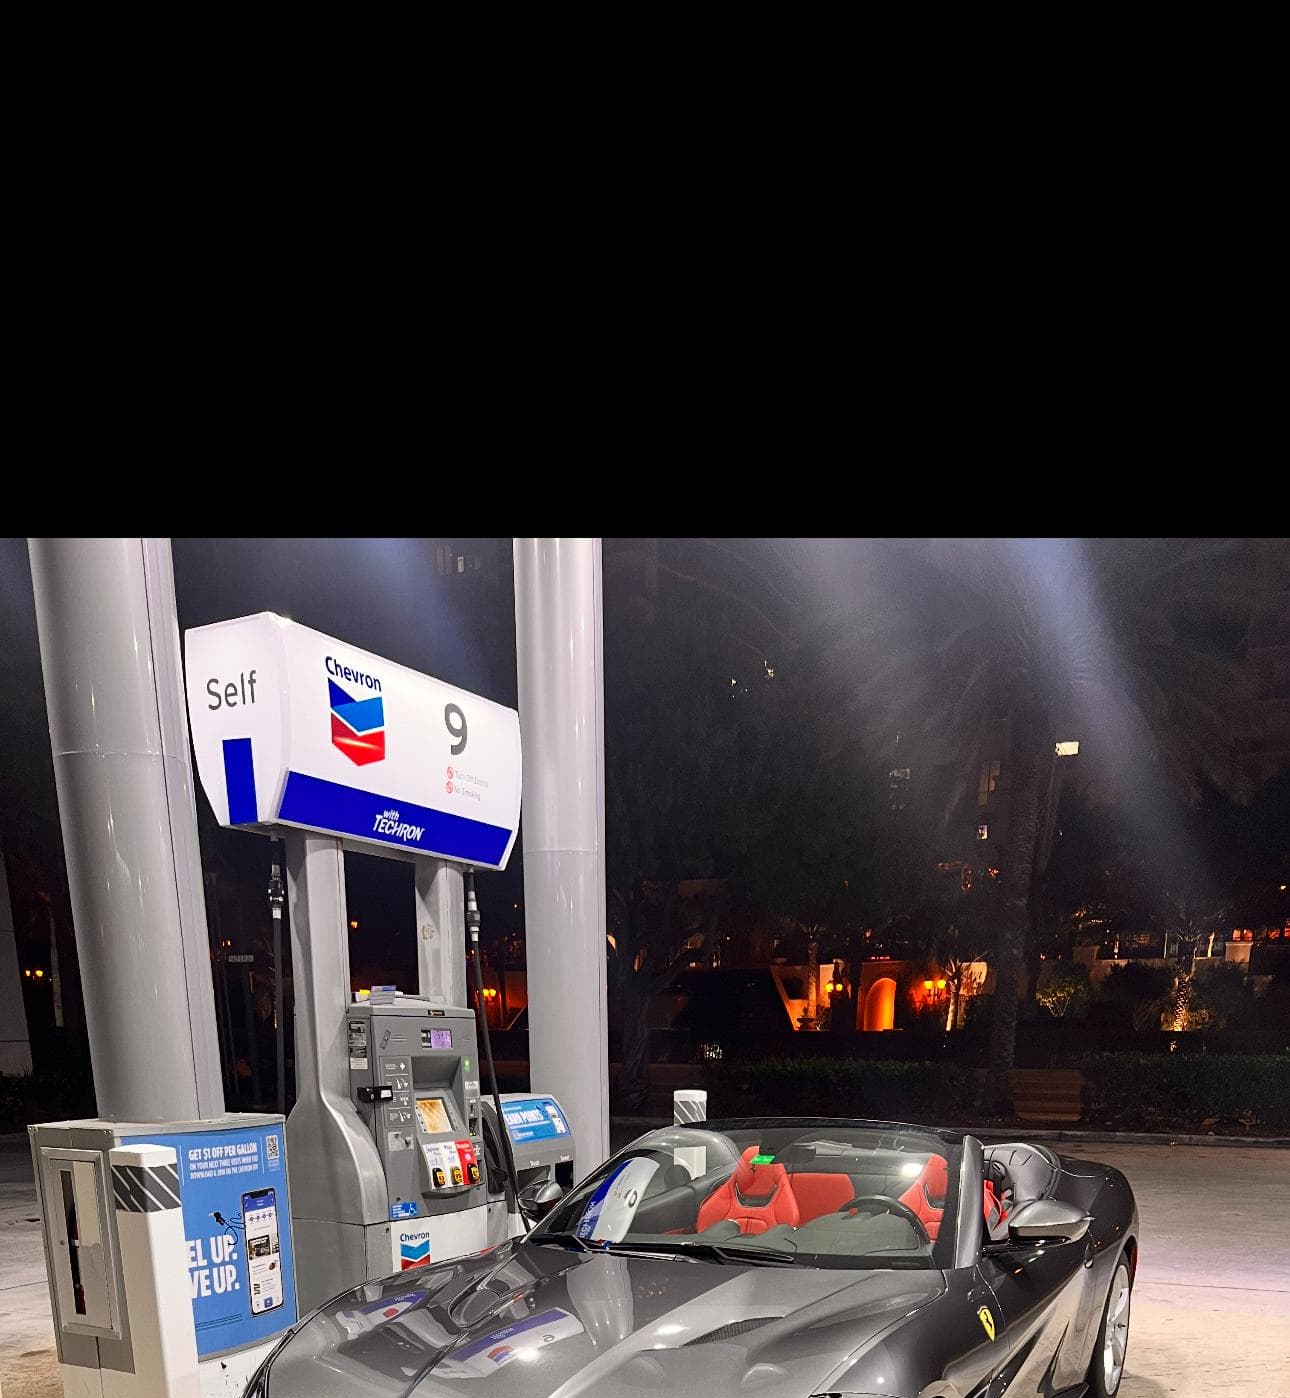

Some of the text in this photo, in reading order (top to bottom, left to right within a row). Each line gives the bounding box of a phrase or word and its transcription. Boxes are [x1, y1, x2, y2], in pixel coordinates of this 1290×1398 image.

[206, 669, 257, 711] Self
[325, 656, 382, 692] Chevron
[444, 703, 467, 756] 9
[373, 814, 425, 842] TECHRON
[383, 809, 400, 821] with
[189, 1143, 258, 1160] GET $1 OFF PER GALLON
[187, 1234, 238, 1268] EL UP.
[400, 1231, 430, 1243] Chevron
[188, 1269, 211, 1299] VE
[212, 1264, 240, 1294] UP.
